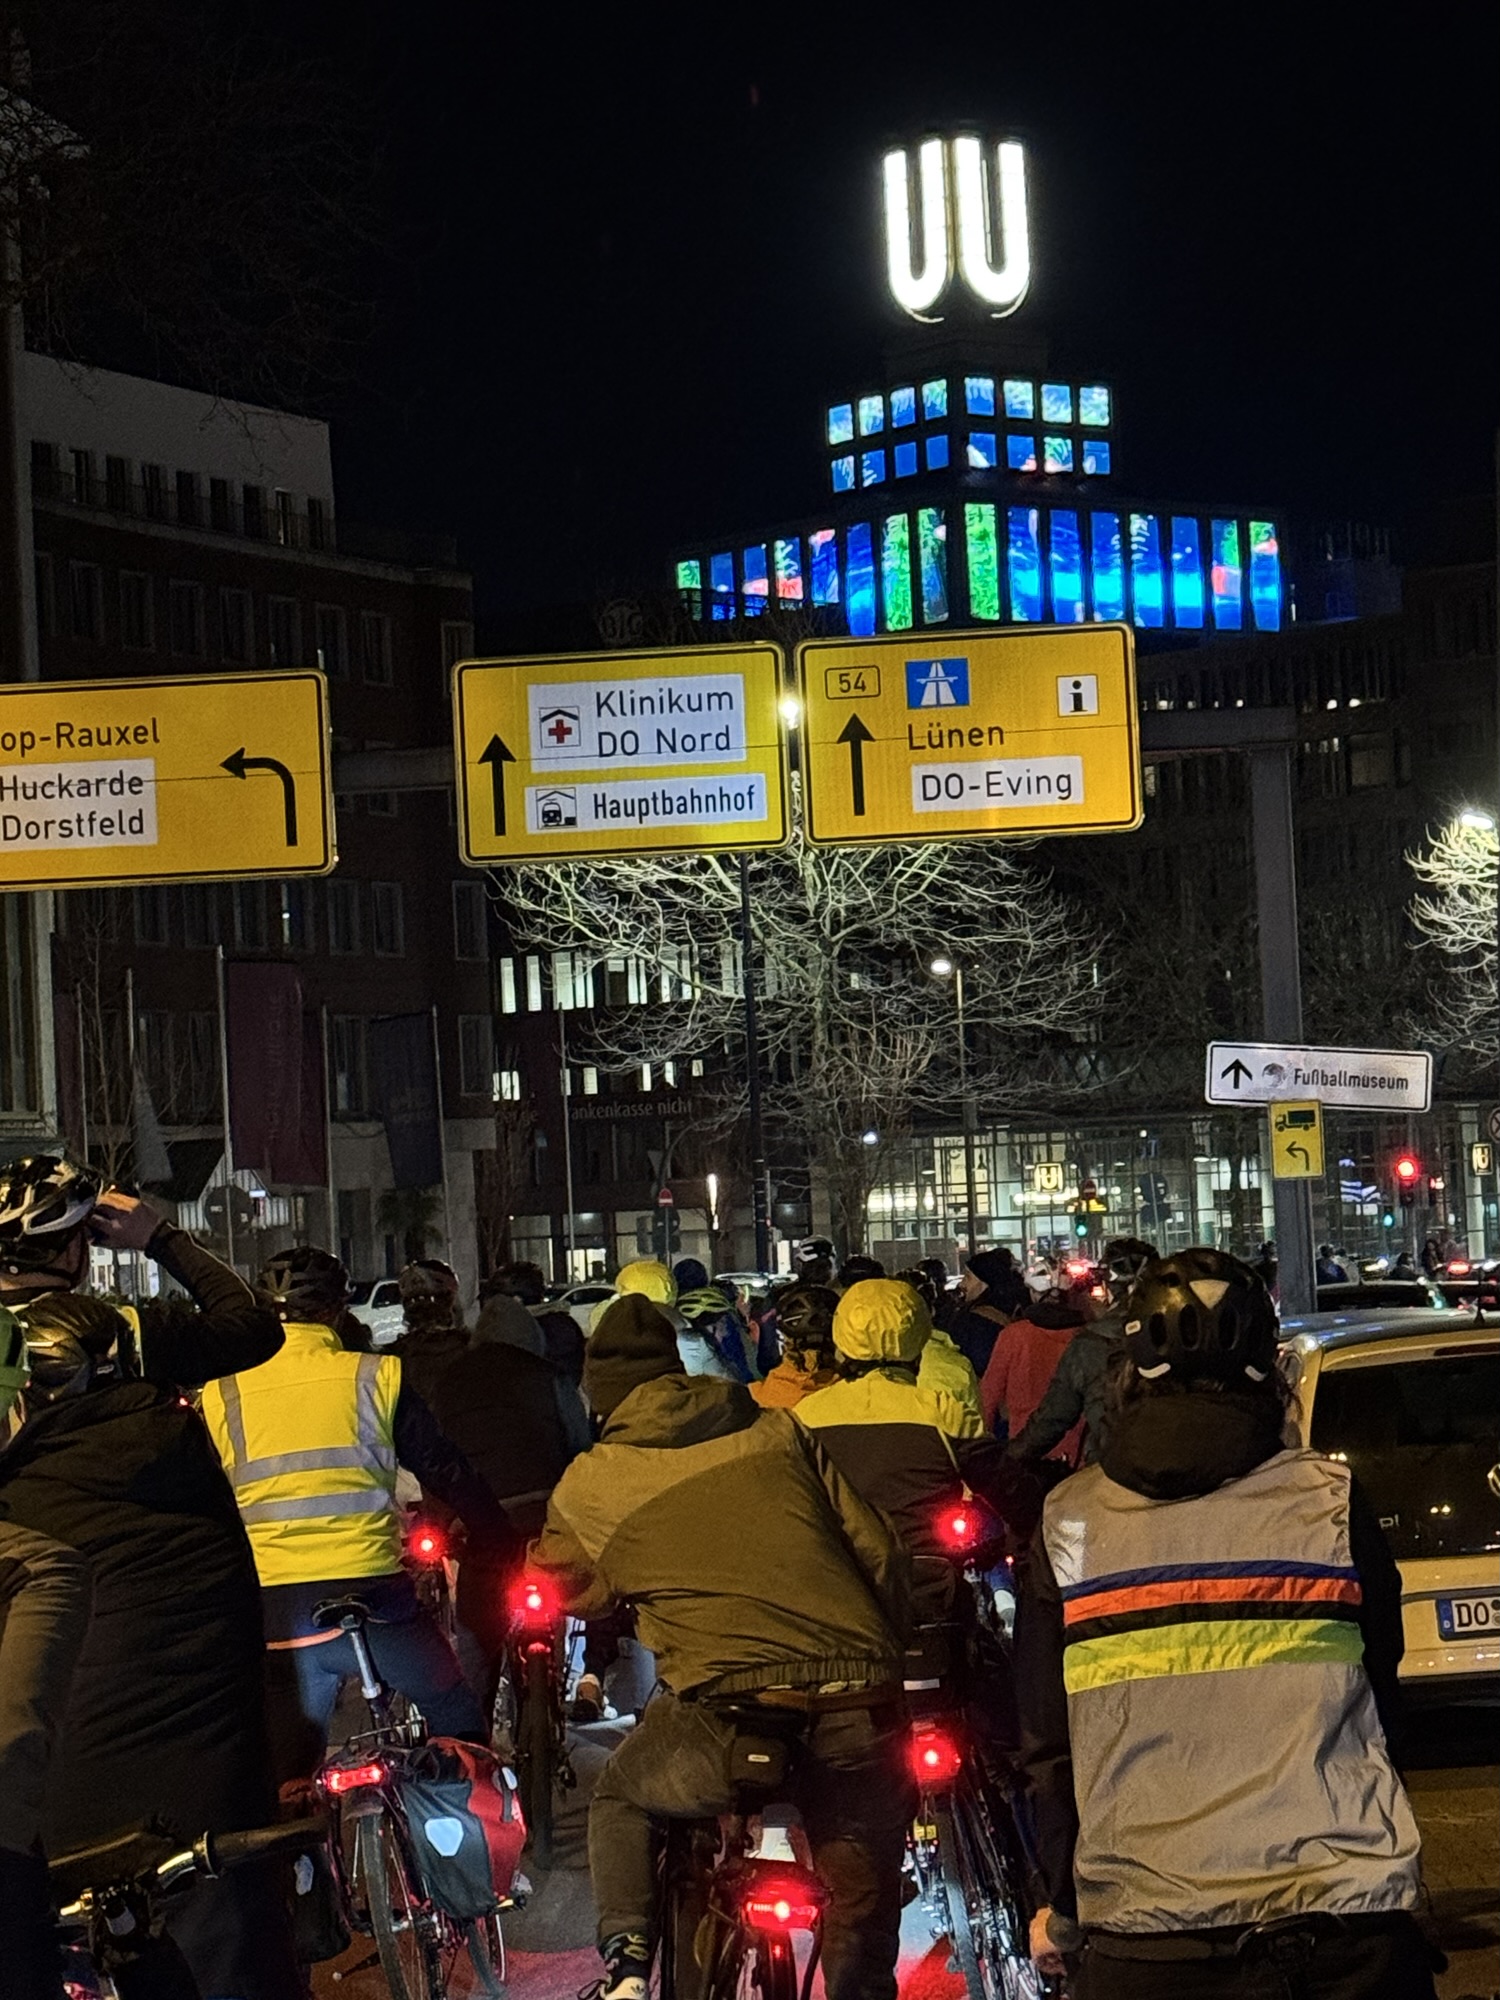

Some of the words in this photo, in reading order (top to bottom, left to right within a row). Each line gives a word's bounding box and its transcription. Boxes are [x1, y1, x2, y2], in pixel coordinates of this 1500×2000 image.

[838, 671, 867, 694] 54
[595, 687, 734, 718] Klinikum
[0, 716, 161, 758] op-Rauxel
[598, 729, 640, 758] DO
[656, 724, 731, 754] Nord
[907, 722, 1005, 751] Lünen
[0, 769, 144, 801] Huckarde
[921, 768, 1073, 801] DO-Eving
[593, 783, 756, 824] Hauptbahnhof
[2, 807, 145, 841] Dorstfeld
[1293, 1067, 1409, 1091] Fußballmuseum
[657, 1096, 692, 1116] nicht
[1454, 1601, 1490, 1628] DO
